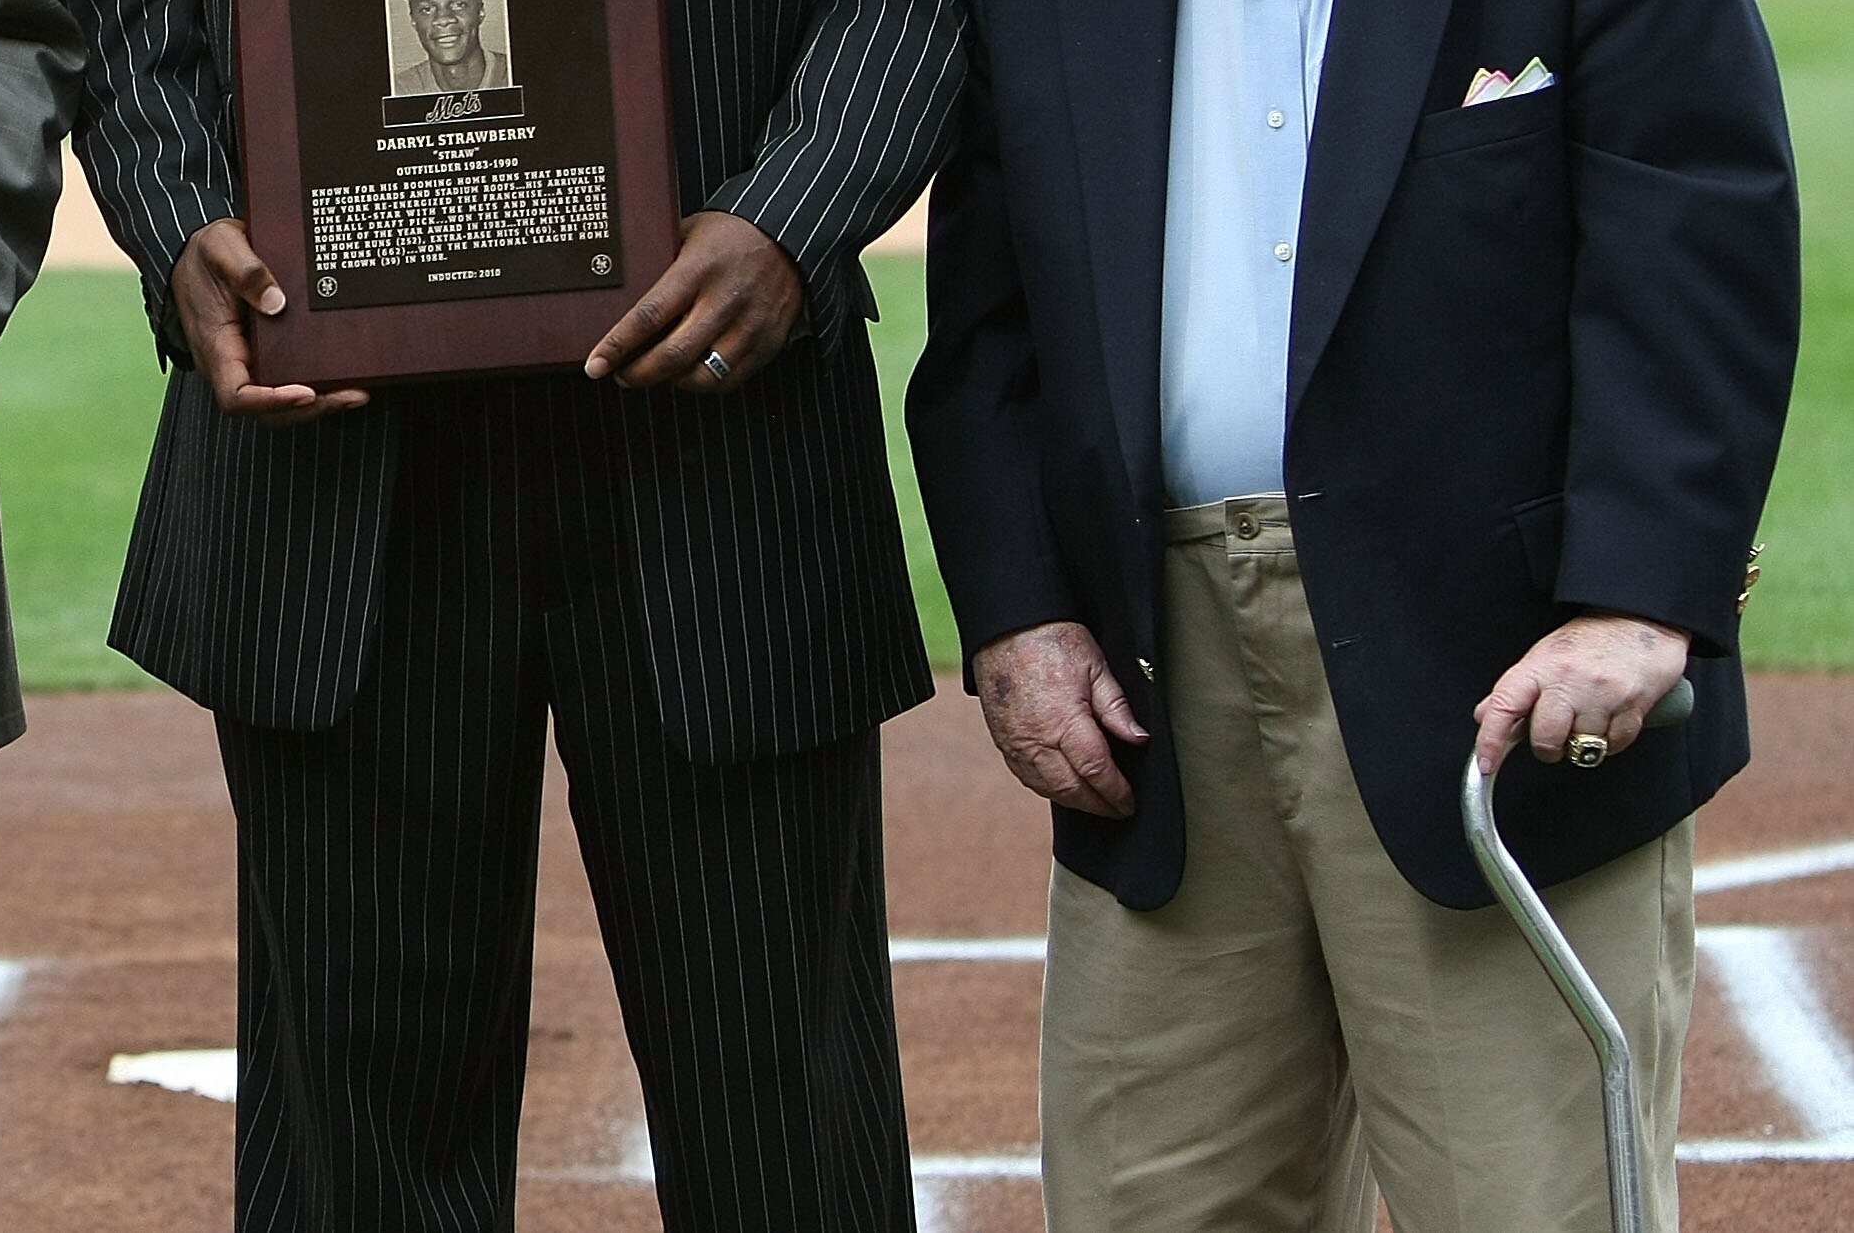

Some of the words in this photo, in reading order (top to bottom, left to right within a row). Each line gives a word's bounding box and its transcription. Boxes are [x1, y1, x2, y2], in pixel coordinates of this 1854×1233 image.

[426, 91, 482, 123] Mets
[377, 135, 434, 151] DARRYL
[438, 127, 535, 146] STRAWBERRY
[312, 187, 350, 197] KNOWN
[355, 185, 375, 193] FOR
[380, 183, 398, 191] HIS
[403, 178, 452, 189] BOOMING
[457, 176, 486, 185] HOME
[492, 173, 519, 182] RUNS
[524, 170, 551, 180] THAT
[556, 166, 605, 177] BOUNCED
[396, 163, 461, 175] OUTFIELDER
[464, 158, 518, 170] 1983-1990
[313, 206, 336, 215] NEW
[340, 203, 369, 213] YORK
[374, 197, 452, 210] RE-ENERGIZED
[457, 195, 477, 204] THE
[567, 185, 606, 195] SEVEN-
[313, 215, 340, 224] TIME
[346, 210, 401, 222] ALL-STAR
[406, 207, 436, 217] WITH
[441, 205, 463, 214] THE
[469, 202, 498, 212] METS
[503, 200, 526, 209] AND
[532, 196, 579, 207] NUMBER
[584, 194, 606, 202] ONE
[314, 222, 363, 233] OVERALL
[368, 219, 404, 229] DRAFT
[478, 212, 498, 220] THE
[504, 207, 560, 218] NATIONAL
[565, 203, 607, 213] LEAGUE
[316, 252, 337, 261] AND
[343, 249, 371, 259] RUNS
[447, 242, 467, 251] THE
[473, 237, 527, 249] NATIONAL
[533, 233, 573, 244] LEAGUE
[579, 231, 609, 240] HOME
[316, 261, 336, 270] RUN
[341, 259, 376, 268] CROWN
[381, 257, 400, 266] (39)
[405, 256, 416, 264] IN
[428, 271, 477, 281] INDUCTED:
[479, 269, 501, 278] 2010
